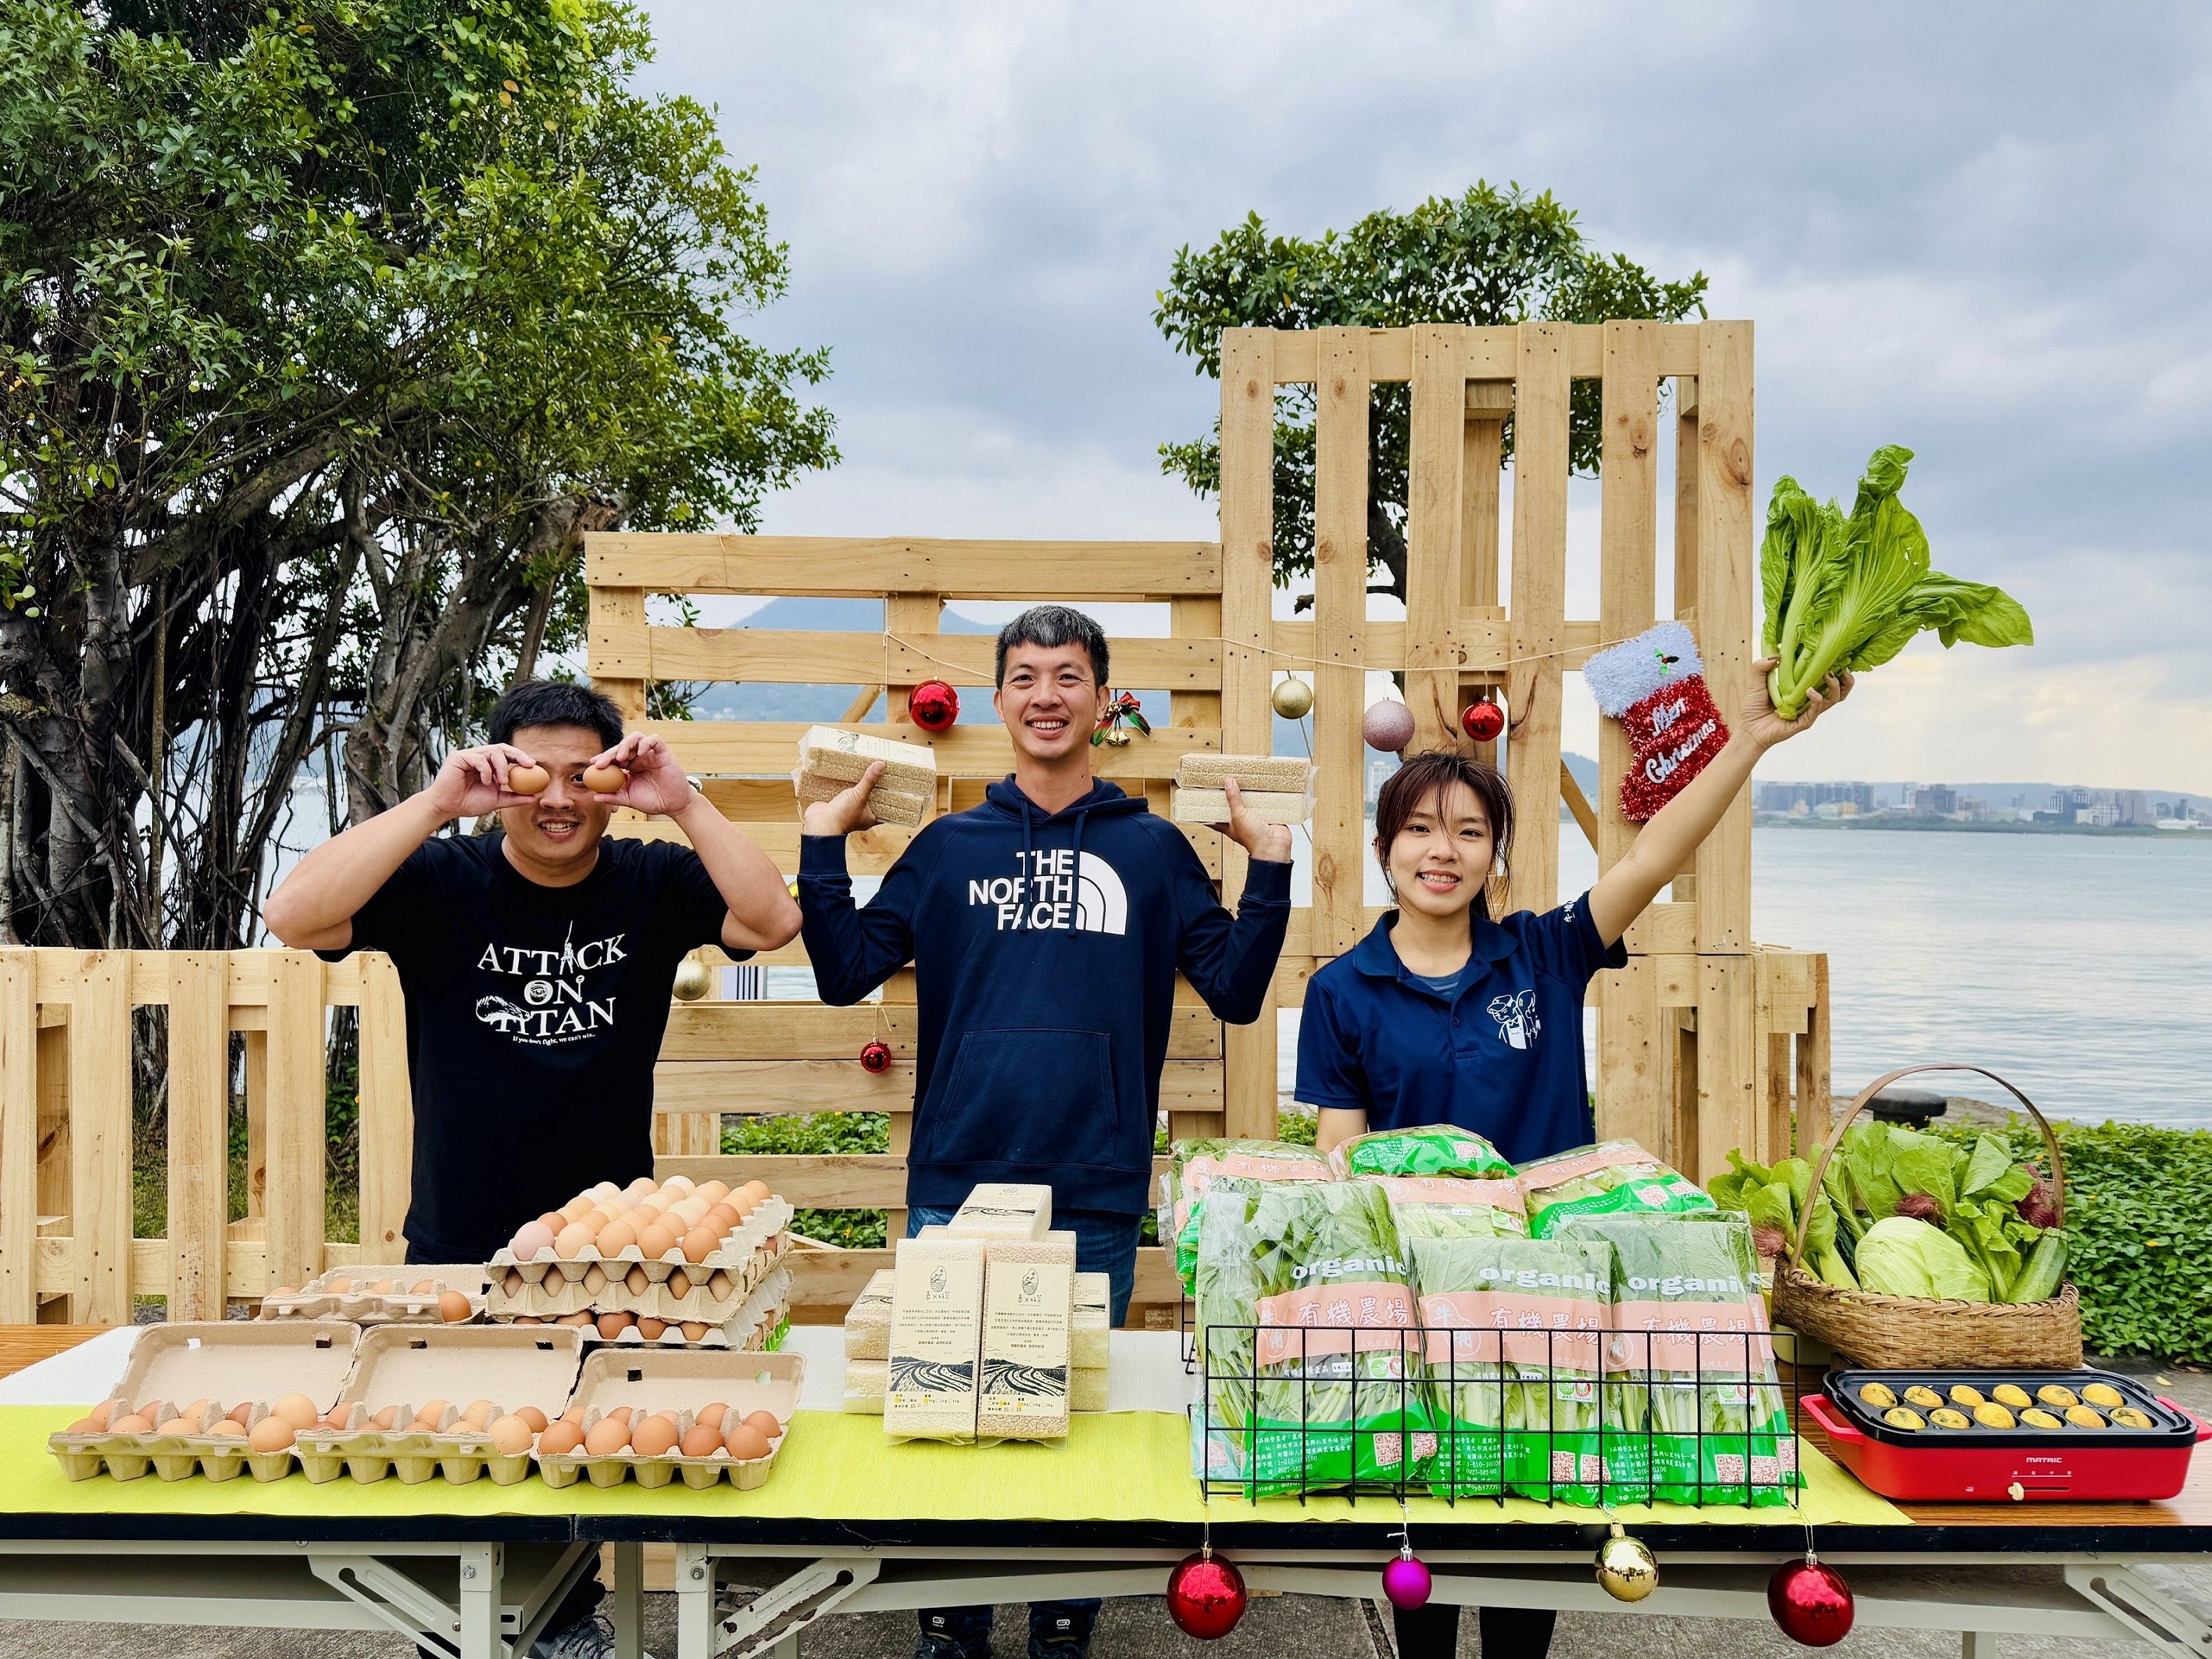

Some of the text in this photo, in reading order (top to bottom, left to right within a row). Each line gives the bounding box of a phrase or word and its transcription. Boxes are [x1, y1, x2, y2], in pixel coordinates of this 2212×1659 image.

[1645, 719, 1717, 784] Christmas
[1016, 849, 1074, 876] THE
[969, 875, 1073, 905] NORTH
[997, 902, 1071, 931] FACE
[477, 922, 627, 975] ATTACK
[524, 975, 585, 1006] ON
[1292, 1255, 1407, 1279] organic
[1479, 1266, 1610, 1294] organic
[1298, 1295, 1409, 1327] 有機農場
[1490, 1306, 1599, 1345] 有機農場
[1642, 1316, 1752, 1346] 有機農場
